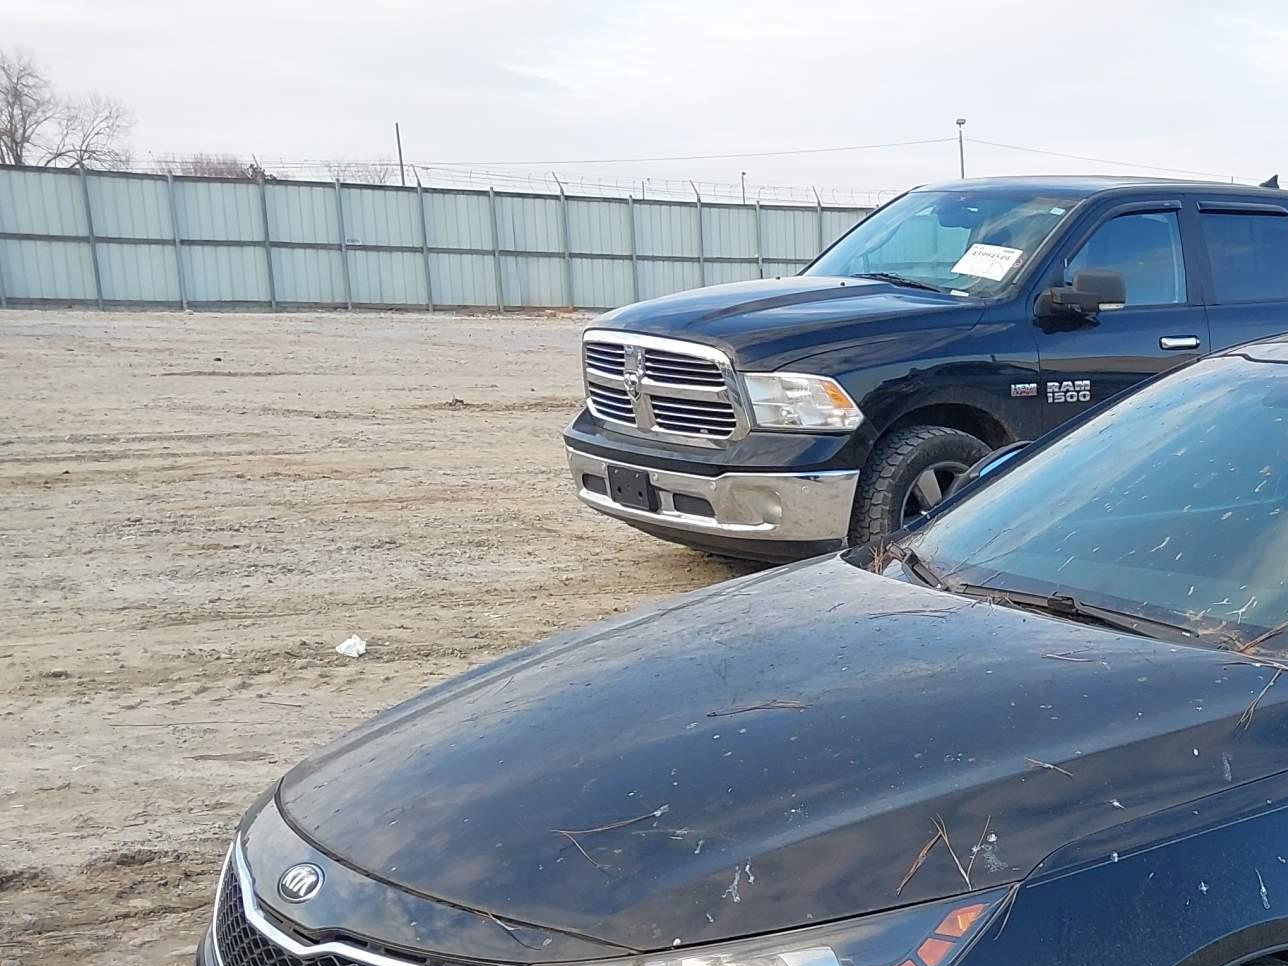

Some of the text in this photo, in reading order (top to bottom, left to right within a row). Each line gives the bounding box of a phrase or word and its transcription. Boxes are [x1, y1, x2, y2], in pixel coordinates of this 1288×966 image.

[1046, 380, 1091, 392] RAM
[1046, 391, 1091, 403] 1500
[282, 867, 317, 897] KIA
